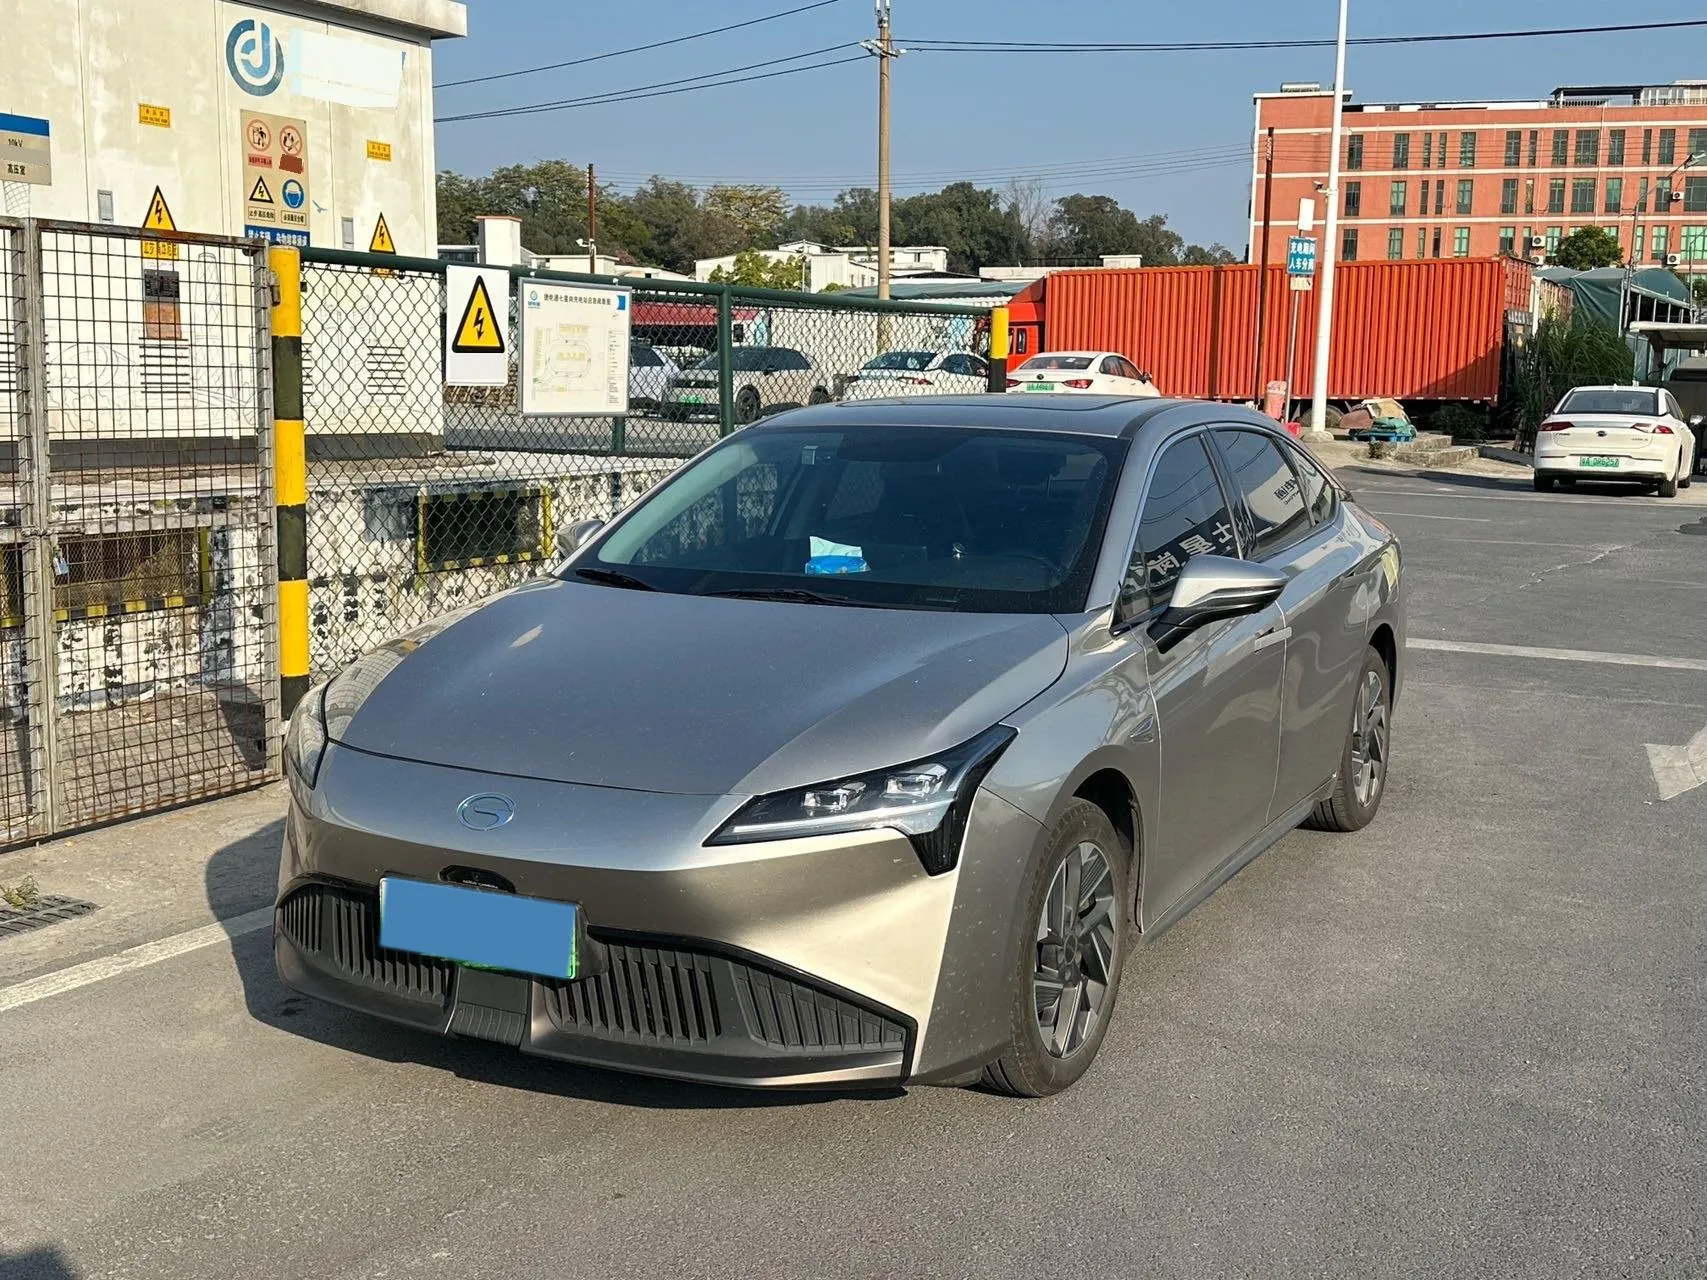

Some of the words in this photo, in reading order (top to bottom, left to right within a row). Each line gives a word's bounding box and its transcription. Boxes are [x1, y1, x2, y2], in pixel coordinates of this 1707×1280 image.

[7, 163, 26, 176] 高压室
[1290, 241, 1315, 255] 充电期间
[1289, 257, 1314, 271] 人车分离
